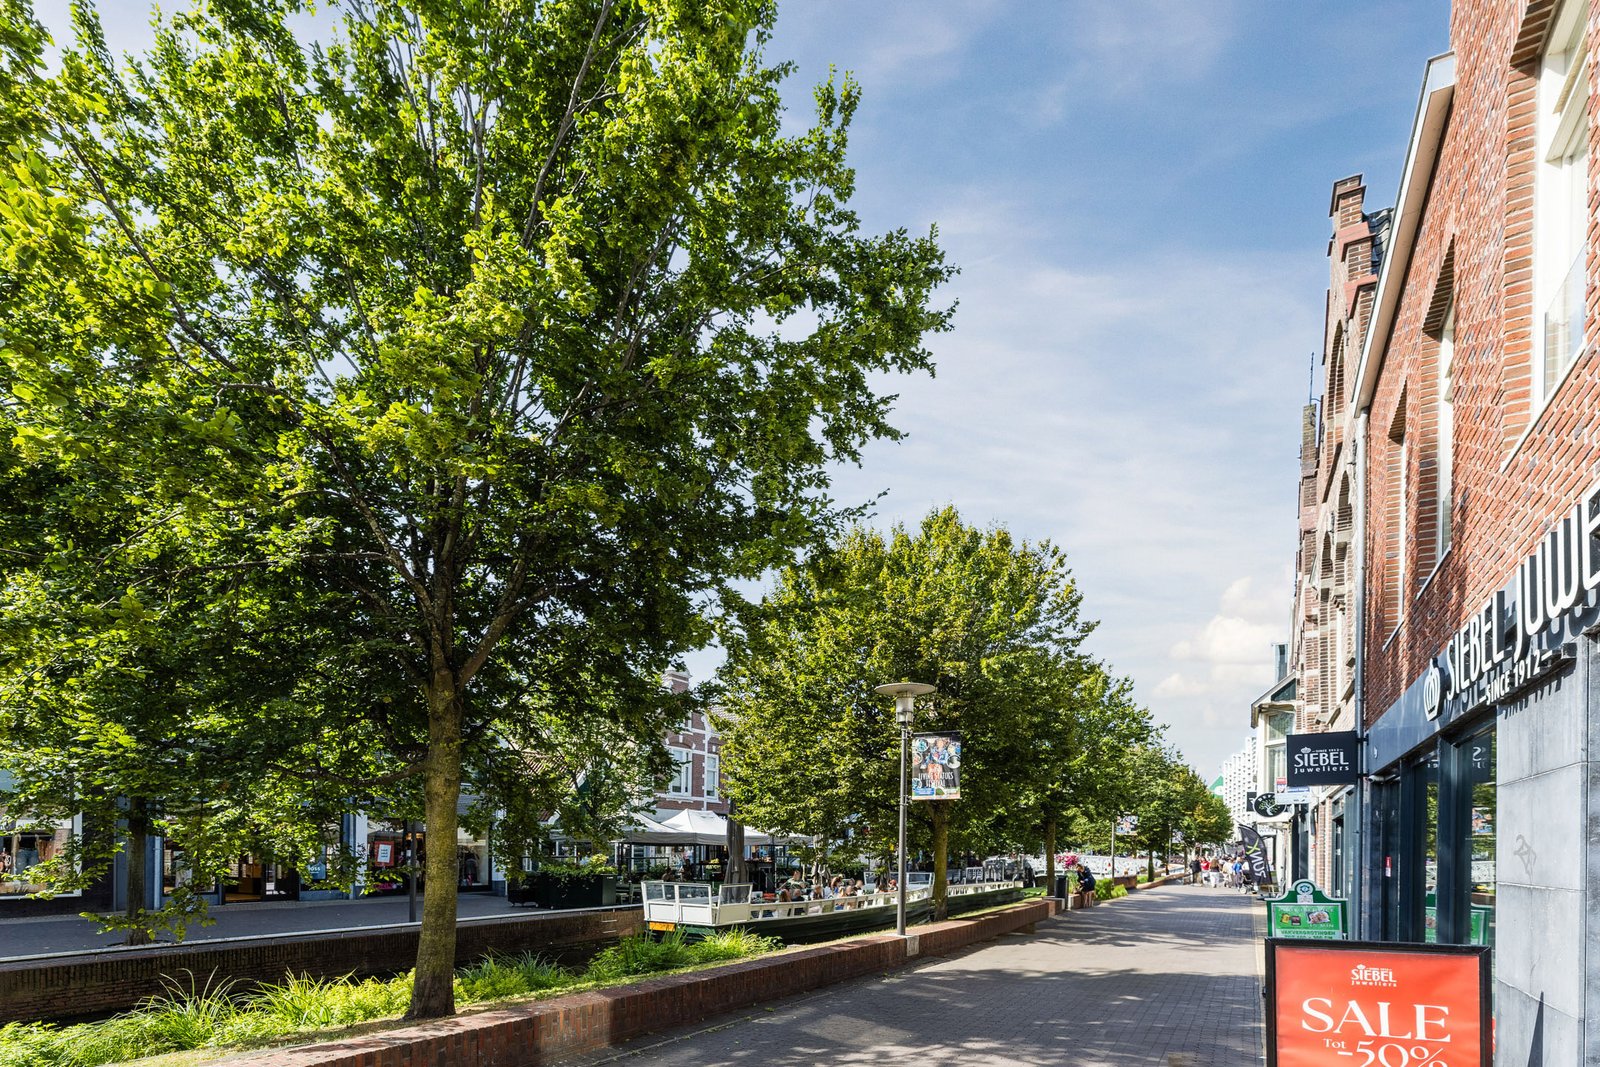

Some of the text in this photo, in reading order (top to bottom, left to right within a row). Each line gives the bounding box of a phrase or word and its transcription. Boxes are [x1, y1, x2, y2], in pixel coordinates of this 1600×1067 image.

[1446, 591, 1505, 701] SIEBEL
[1486, 648, 1540, 705] SINCE 1912
[1294, 751, 1349, 768] SIEBEL
[1351, 968, 1397, 982] SIEBEL
[1302, 997, 1451, 1043] SALE
